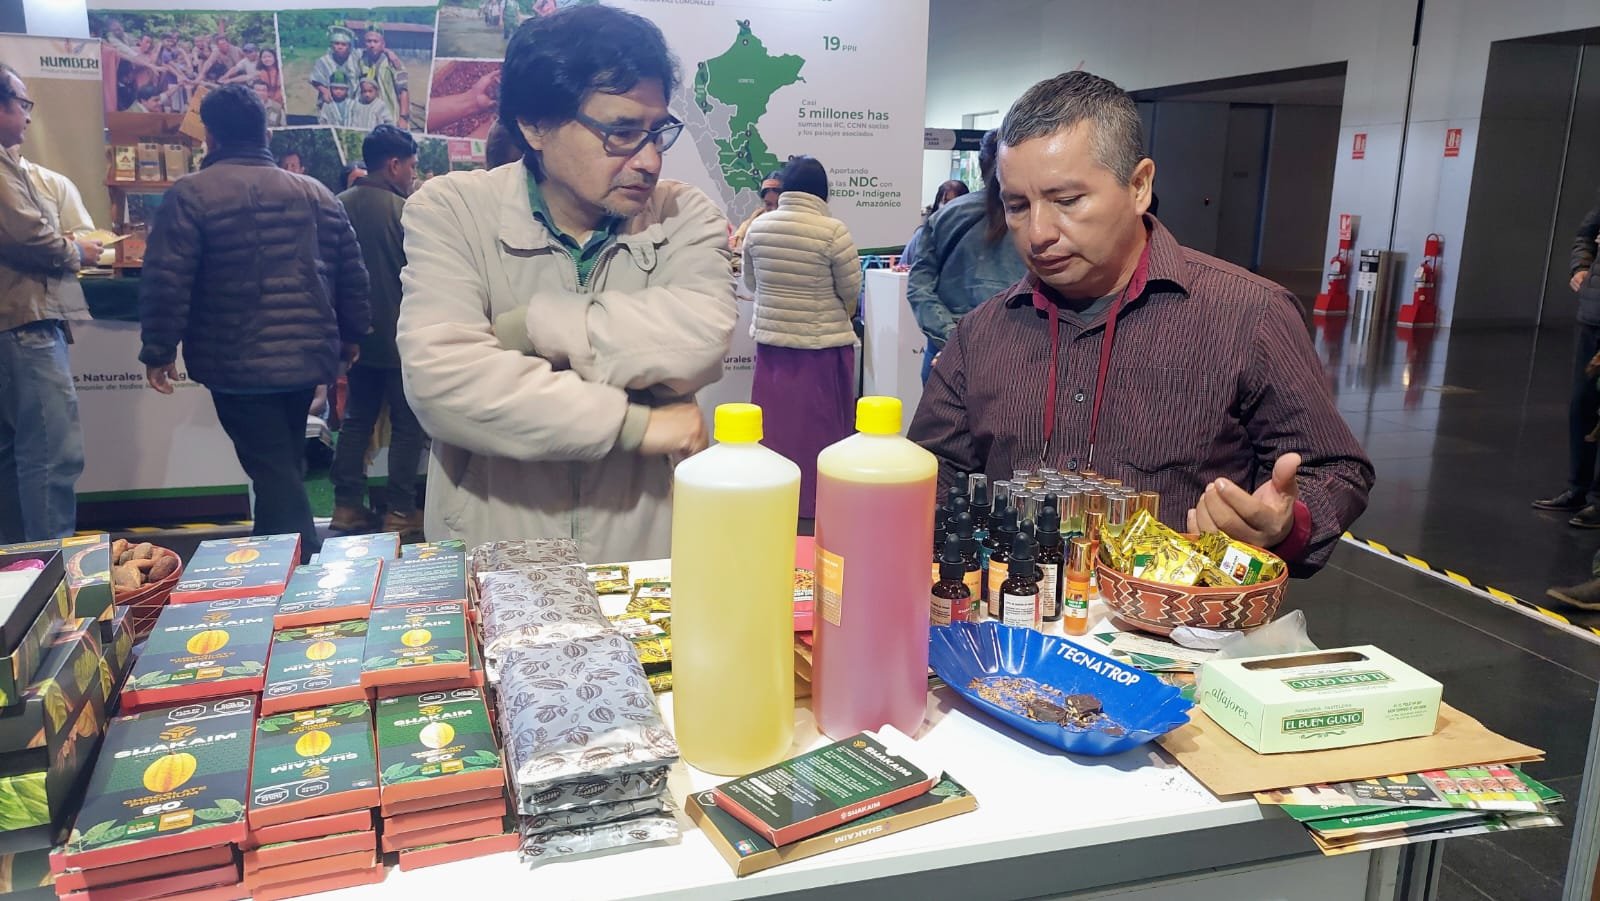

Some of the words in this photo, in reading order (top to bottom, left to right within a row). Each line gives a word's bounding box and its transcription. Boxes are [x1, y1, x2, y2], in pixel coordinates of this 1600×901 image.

[823, 36, 840, 51] 19
[798, 107, 806, 118] 5
[809, 107, 864, 120] millones
[867, 109, 889, 121] has
[849, 176, 878, 187] NDC
[723, 354, 752, 363] urales
[83, 372, 143, 382] Naturales
[164, 617, 264, 632] SHAKAIM
[1056, 642, 1141, 687] TECNATROP
[1291, 677, 1337, 689] GUSTO
[1211, 688, 1249, 720] alfajores
[393, 709, 473, 727] SHAKAIM
[1286, 720, 1297, 730] EL
[1298, 717, 1324, 729] BUEN
[1326, 713, 1361, 725] GUSTO
[114, 732, 238, 759] SHAKAIM
[270, 751, 359, 774] SHAKAIM
[864, 746, 913, 777] SHAKAIM
[847, 801, 881, 817] SHAKAIM
[834, 824, 884, 844] SHAKAIM
